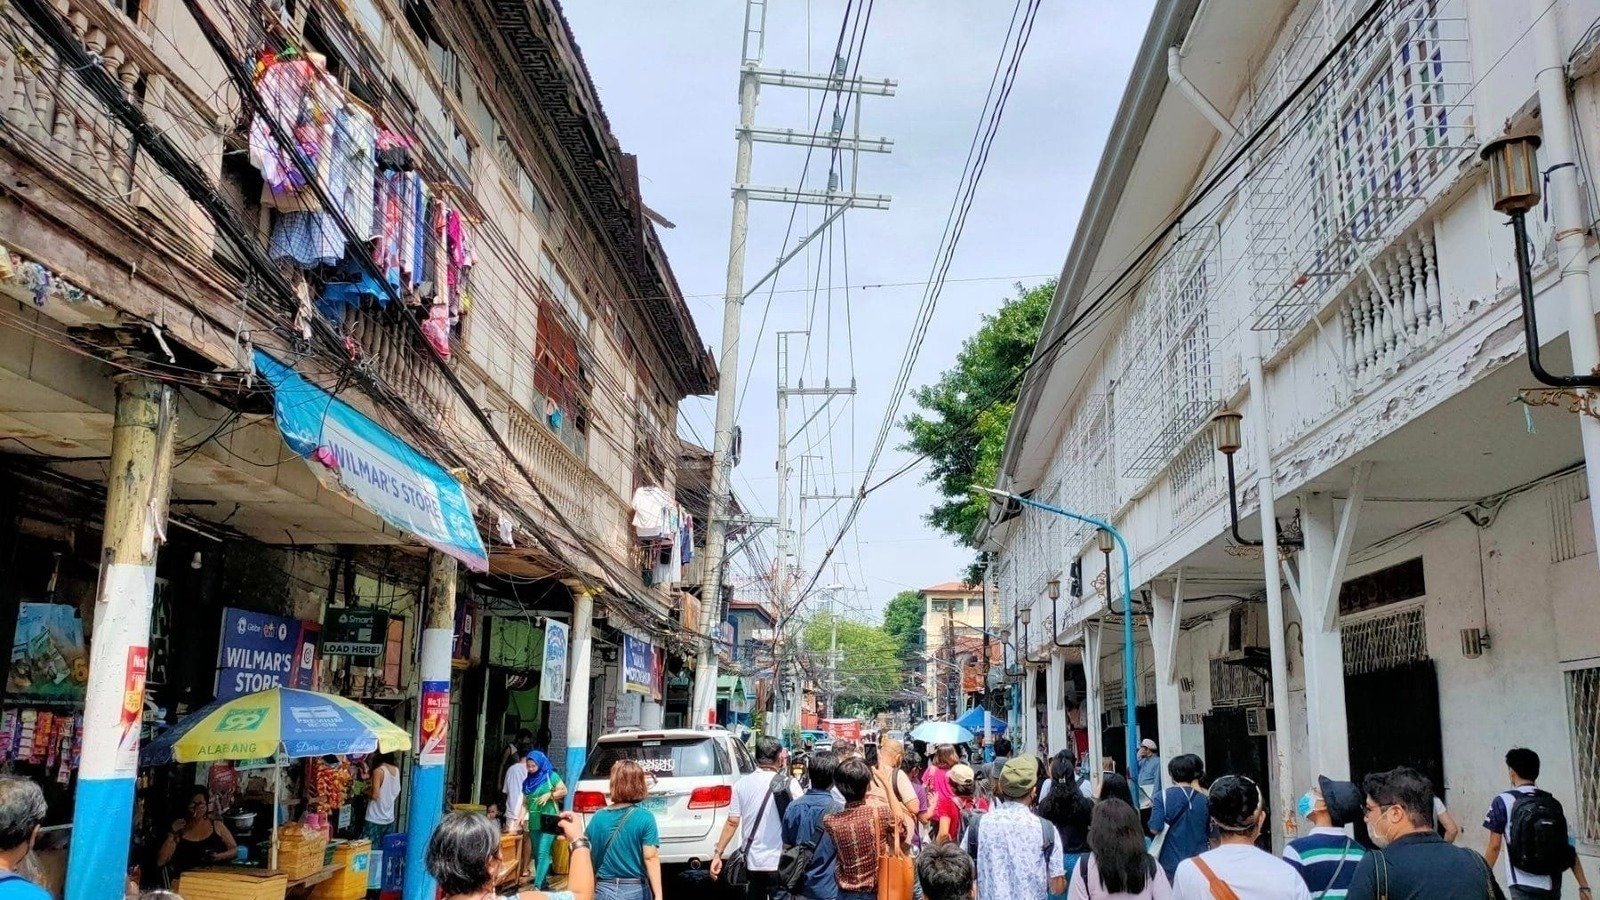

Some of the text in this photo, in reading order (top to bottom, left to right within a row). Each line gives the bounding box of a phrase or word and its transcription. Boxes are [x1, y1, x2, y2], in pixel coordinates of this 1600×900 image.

[328, 440, 399, 498] WILMAR'S
[402, 482, 441, 520] STORE
[349, 615, 374, 624] Smart
[324, 645, 380, 654] LOAD HERE!
[227, 647, 292, 673] WILMAR'S
[235, 672, 280, 693] STORE
[197, 743, 257, 756] ALABANG
